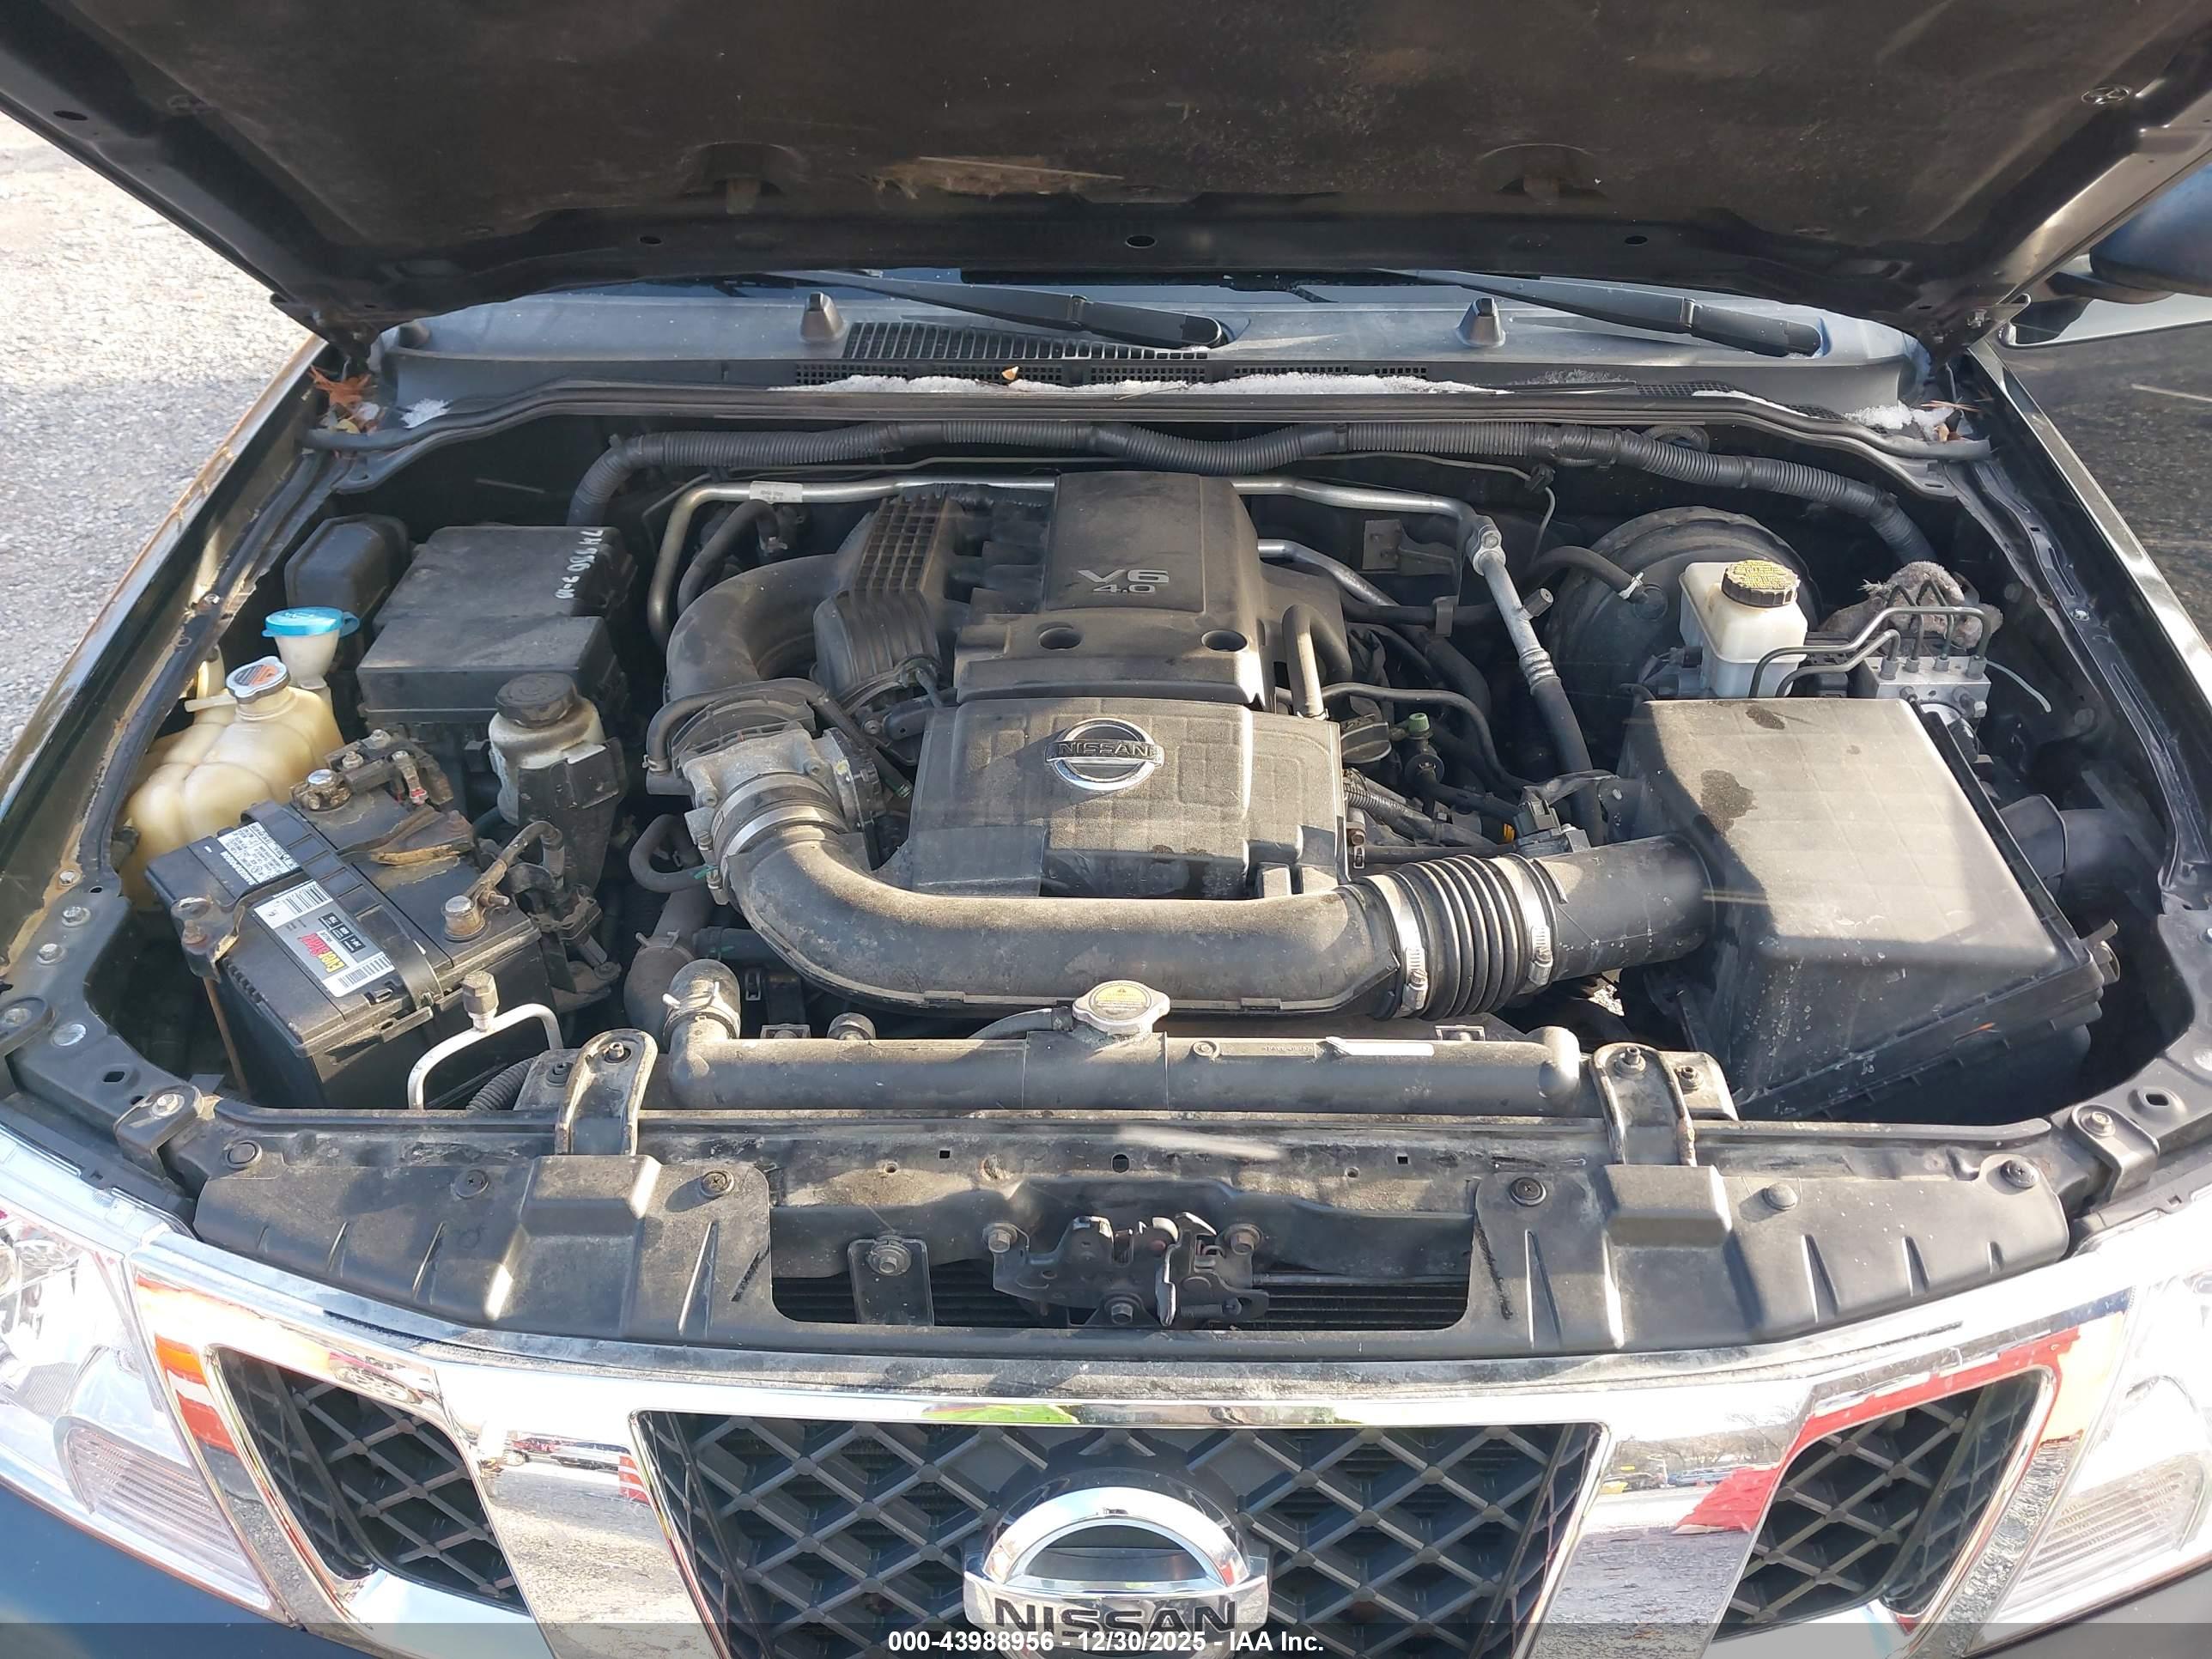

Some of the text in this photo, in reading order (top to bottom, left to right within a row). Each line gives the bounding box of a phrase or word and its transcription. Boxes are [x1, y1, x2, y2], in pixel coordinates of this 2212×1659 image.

[1078, 568, 1170, 584] V6
[1092, 584, 1156, 594] 4.0
[1057, 741, 1152, 757] NISSAN
[301, 933, 347, 974] EverStart
[994, 1597, 1237, 1640] NISSAN
